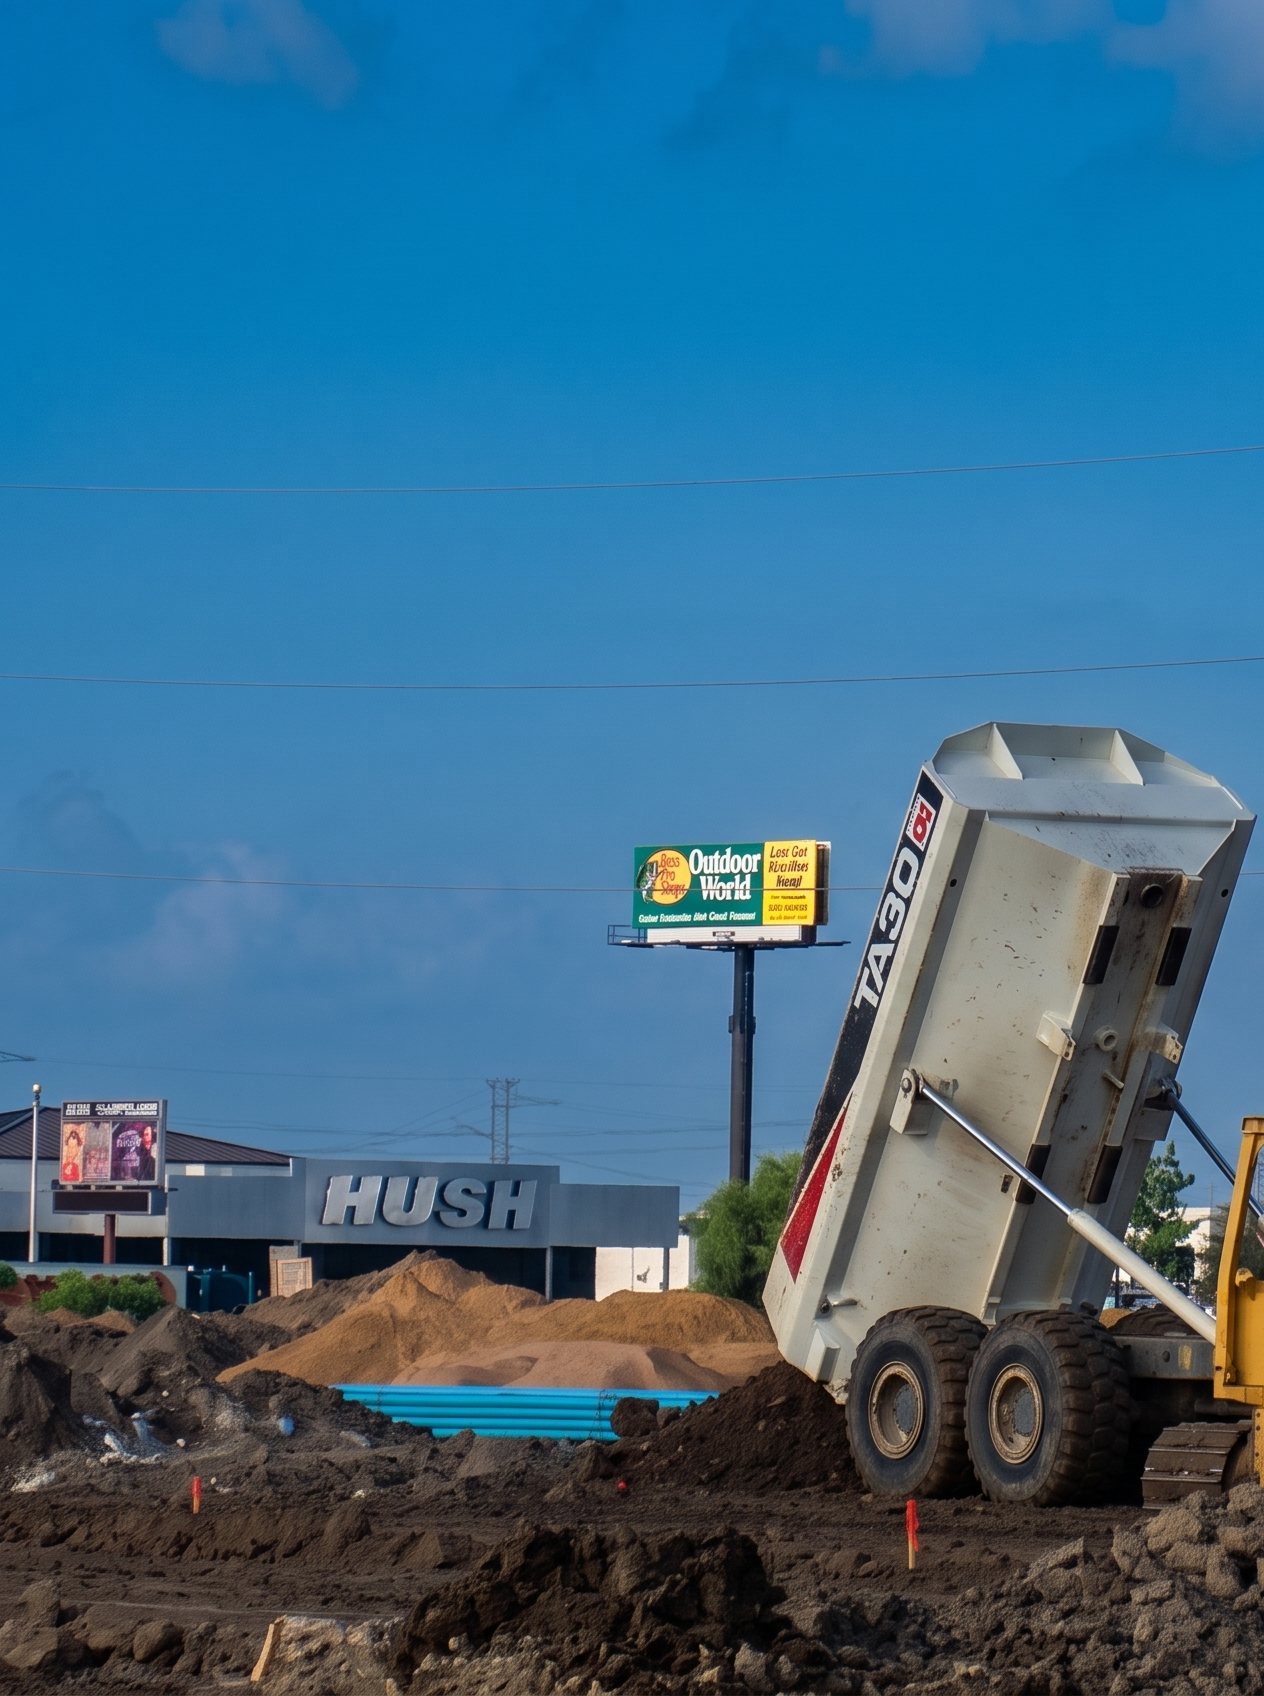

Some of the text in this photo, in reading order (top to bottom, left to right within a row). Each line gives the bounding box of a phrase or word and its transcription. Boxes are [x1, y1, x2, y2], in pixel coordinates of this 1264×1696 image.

[689, 847, 762, 875] Outdoor
[700, 874, 751, 901] World
[854, 847, 919, 1009] TA30
[322, 1175, 538, 1230] HUSH
